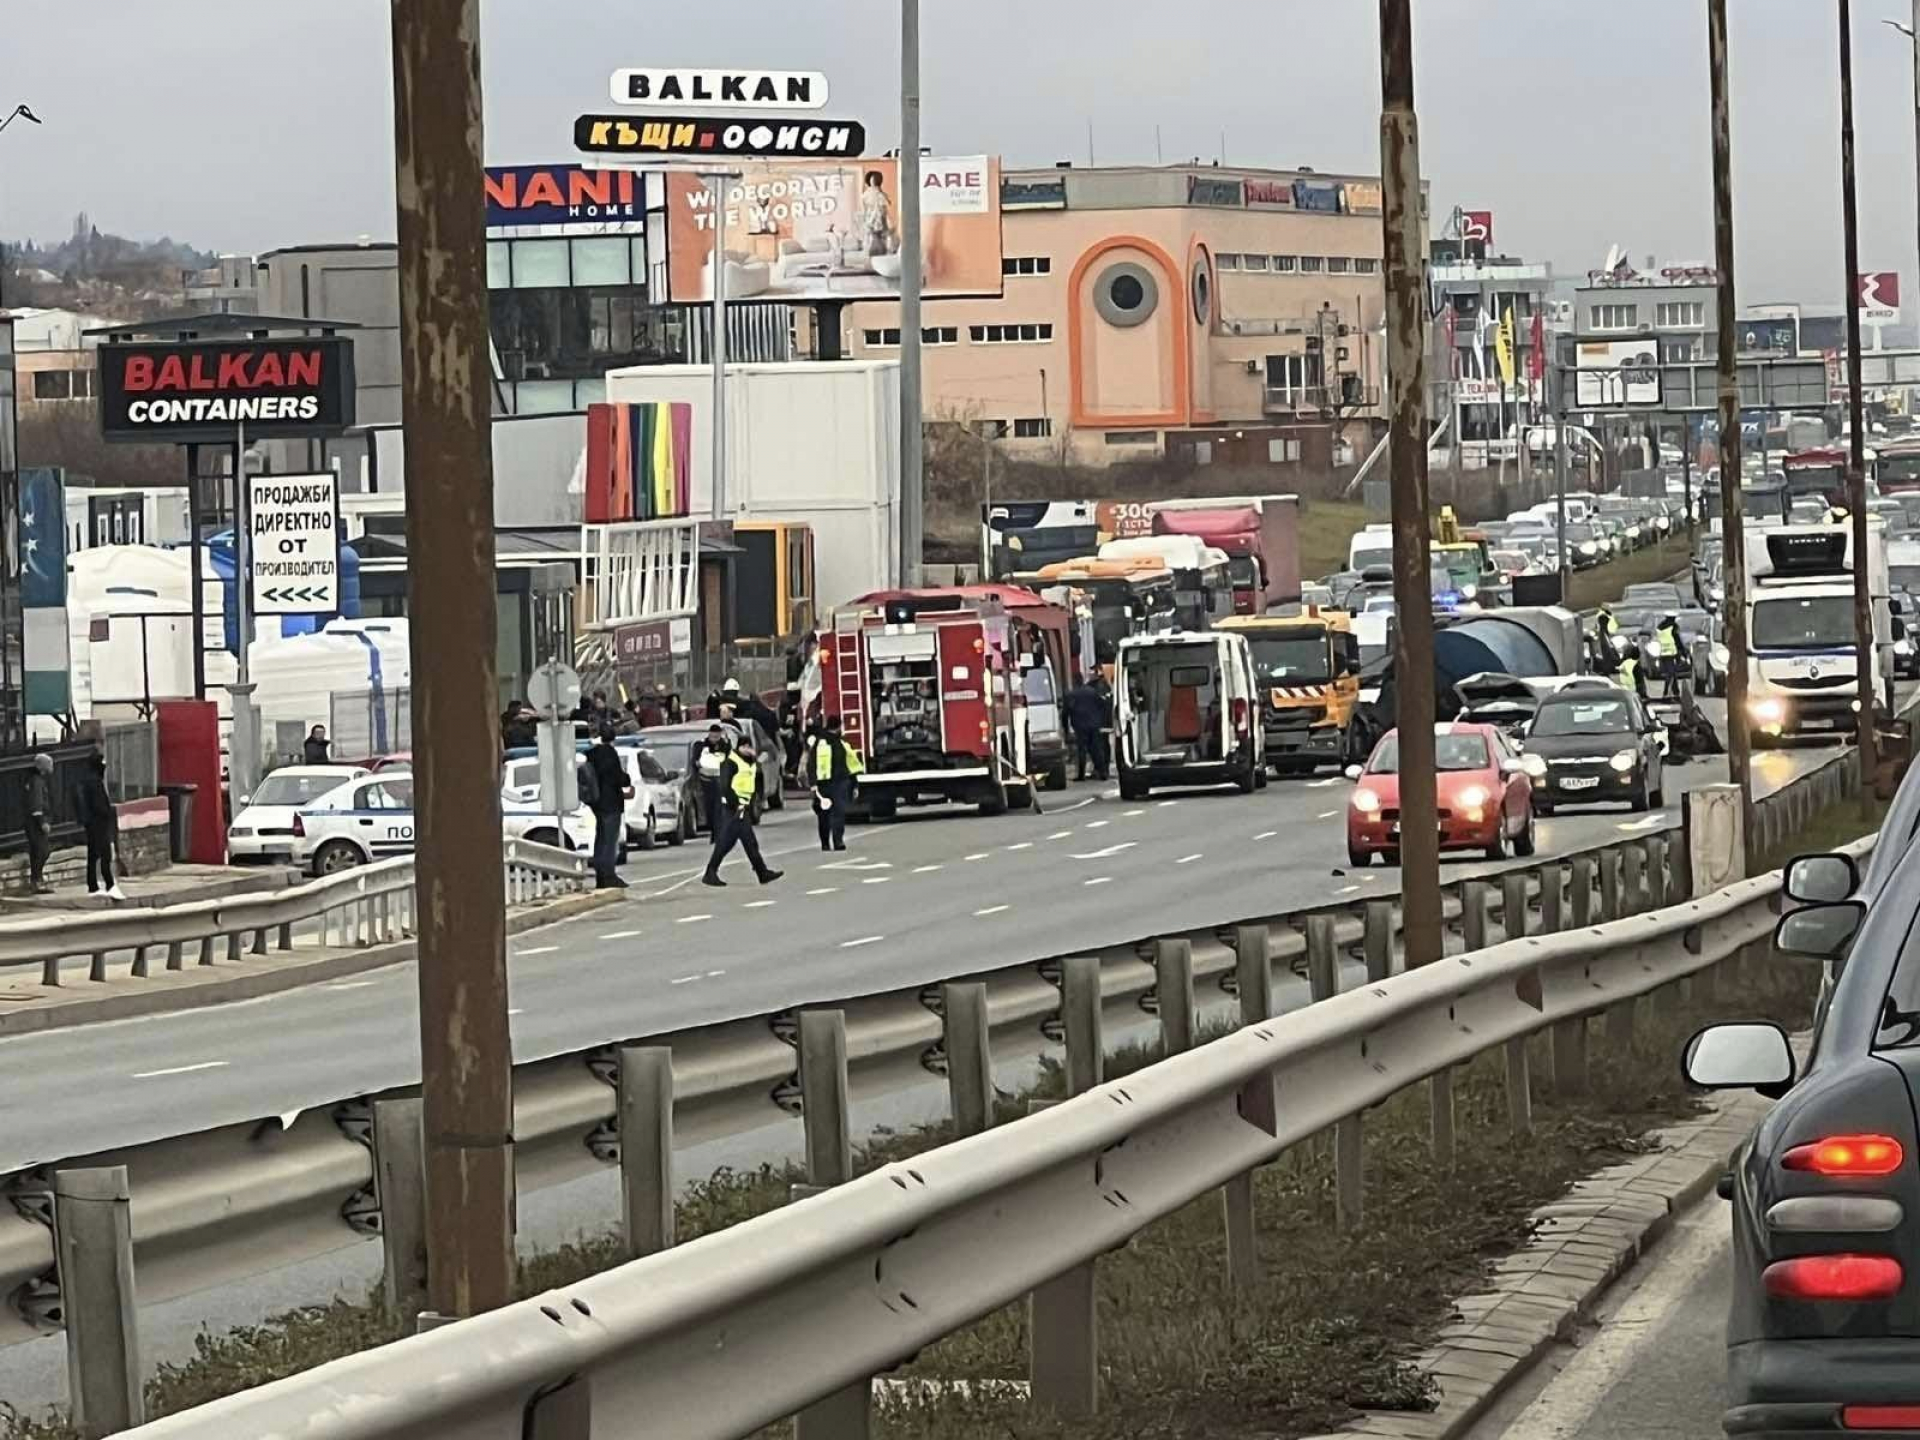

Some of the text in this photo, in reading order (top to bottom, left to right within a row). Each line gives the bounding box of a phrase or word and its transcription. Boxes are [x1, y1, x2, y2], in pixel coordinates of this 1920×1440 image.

[628, 74, 811, 102] BALKAN
[589, 121, 850, 151] КЪЩИ ОФИСИ
[730, 174, 842, 201] DECORATE
[569, 204, 633, 216] HOME
[749, 196, 837, 222] WORLD
[124, 351, 321, 391] BALKAN
[128, 395, 319, 423] CONTAINERS
[254, 484, 331, 507] ПРОДАЖБИ
[254, 511, 332, 536] ДИРЕКТНО
[278, 538, 307, 554] ОТ
[255, 560, 335, 577] ПРОИЗВОДИТЕЛ
